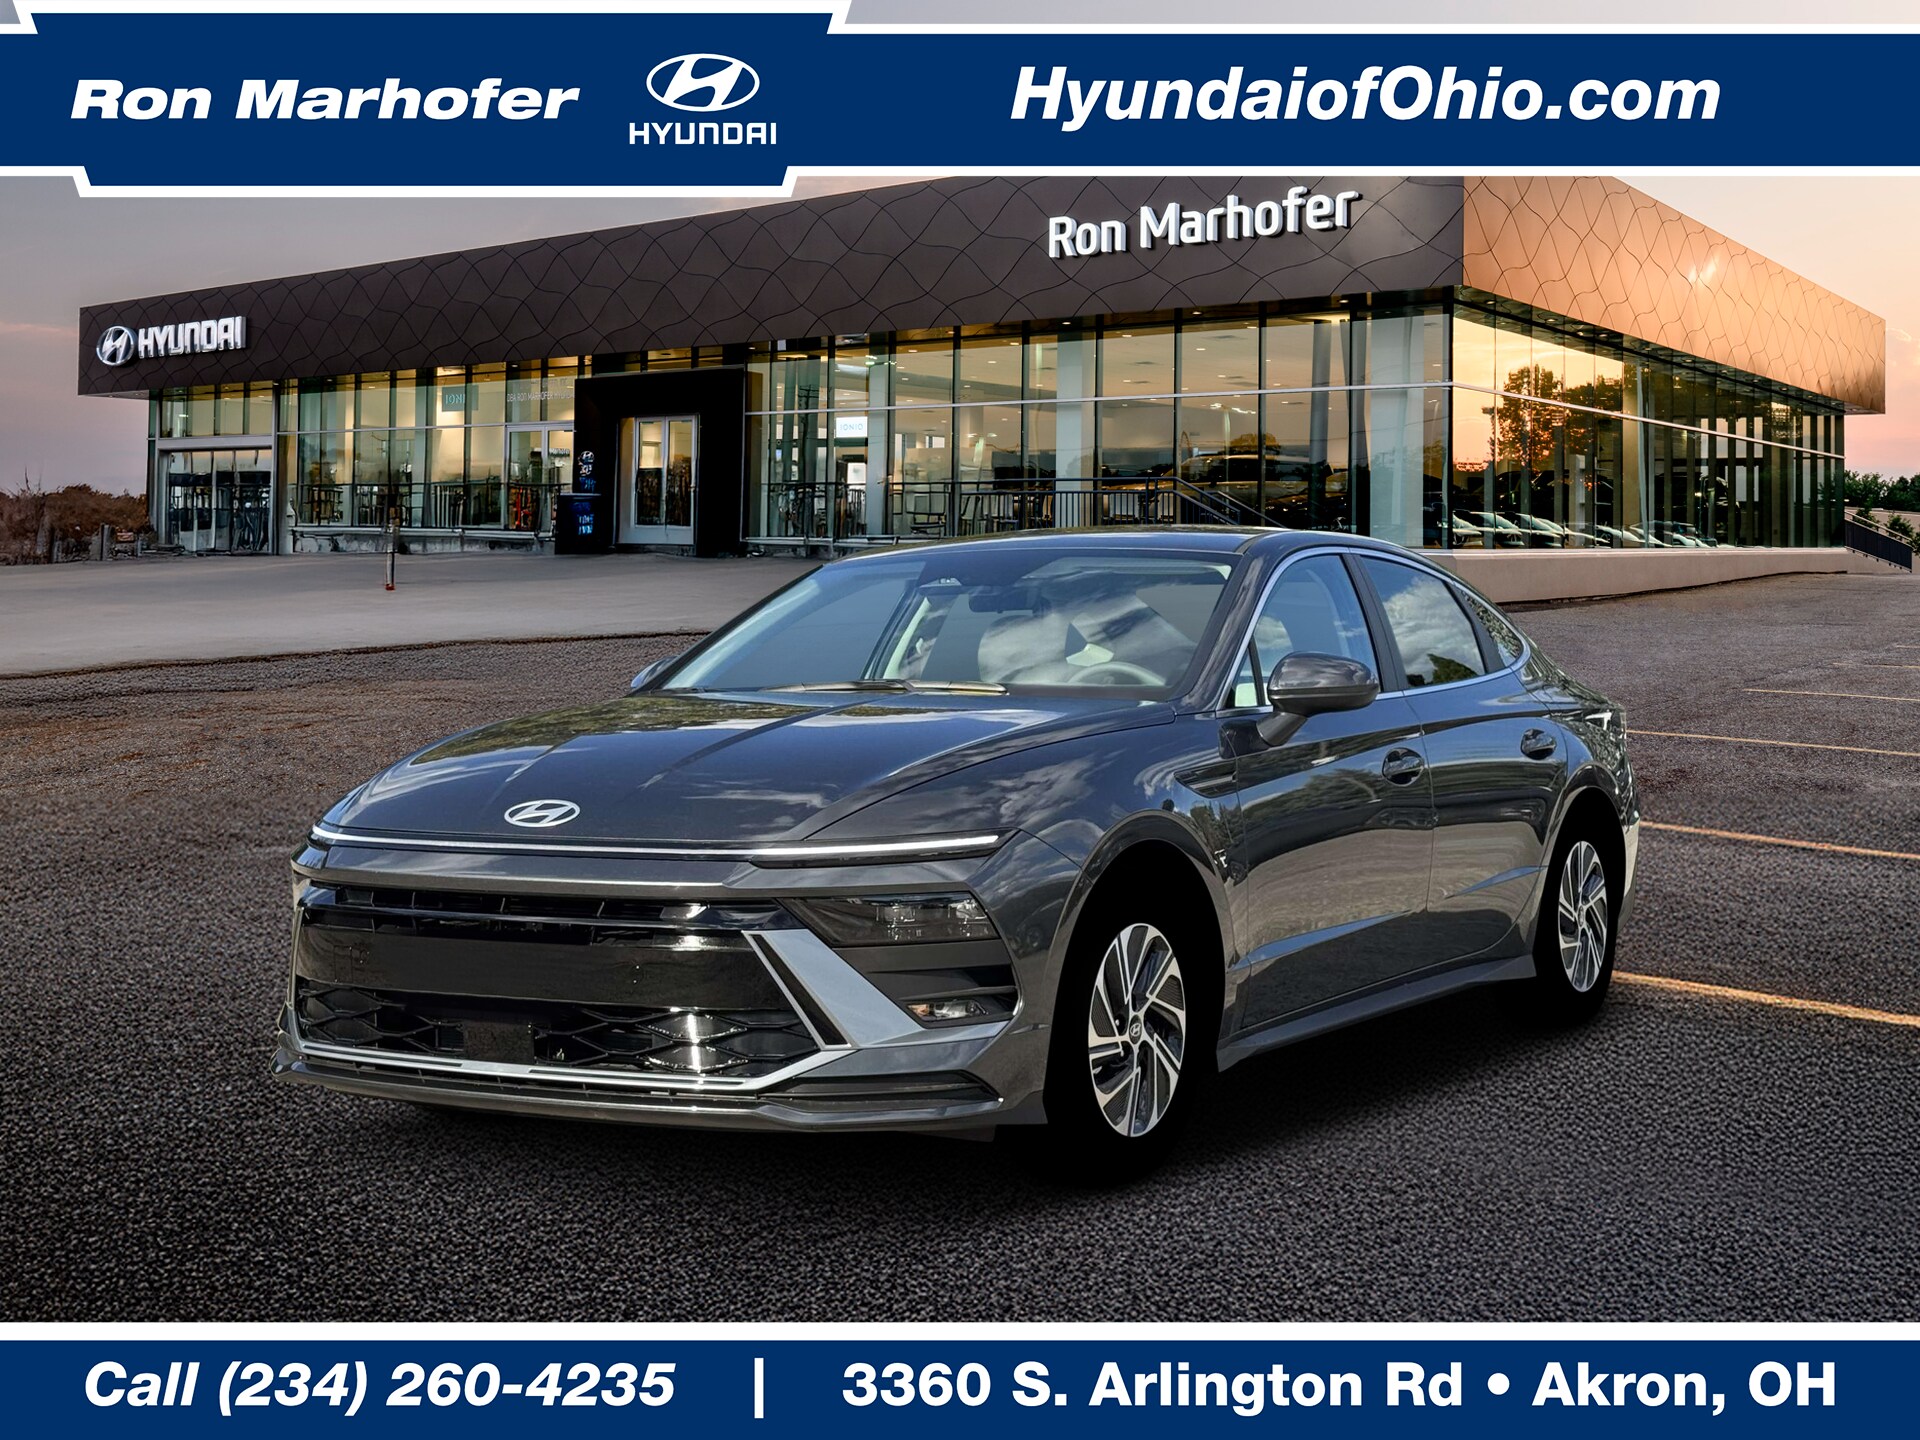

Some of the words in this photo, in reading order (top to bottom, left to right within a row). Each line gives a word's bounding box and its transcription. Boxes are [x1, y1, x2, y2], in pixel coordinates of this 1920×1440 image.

[1048, 215, 1127, 259] Ron
[1140, 185, 1360, 249] Marhofer
[137, 315, 247, 360] HYUNDAI
